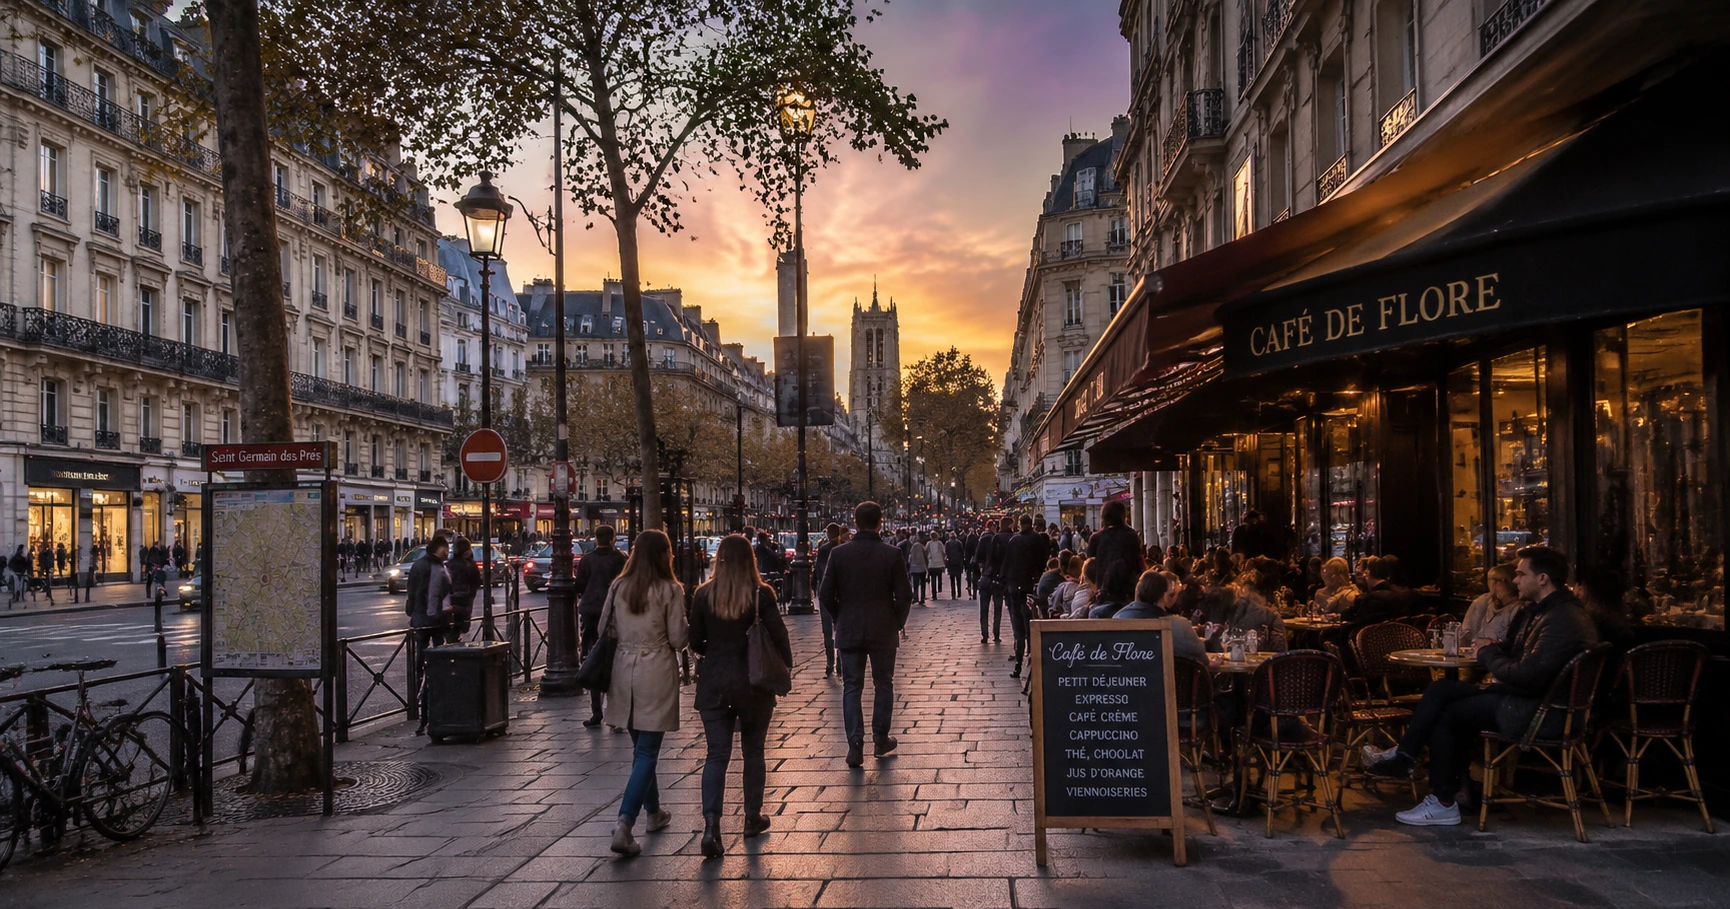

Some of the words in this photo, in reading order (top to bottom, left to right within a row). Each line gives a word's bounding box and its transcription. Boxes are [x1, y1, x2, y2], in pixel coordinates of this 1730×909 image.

[1251, 309, 1313, 356] CAFÉ
[1325, 304, 1364, 341] DE
[1378, 273, 1500, 330] FLORE
[239, 450, 276, 463] Germain
[300, 449, 321, 461] Prés
[1049, 642, 1085, 669] Café
[1090, 644, 1107, 661] de
[1112, 642, 1154, 661] Flore
[1059, 677, 1088, 687] PETIT
[1093, 674, 1146, 688] DÉJEUNER
[1070, 730, 1138, 741] CAPPUCCINO
[1065, 746, 1089, 761] THÉ,
[1067, 768, 1086, 779] JUS
[1091, 768, 1144, 779] D'ORANGE
[1067, 787, 1147, 798] VIENNOISERIES
